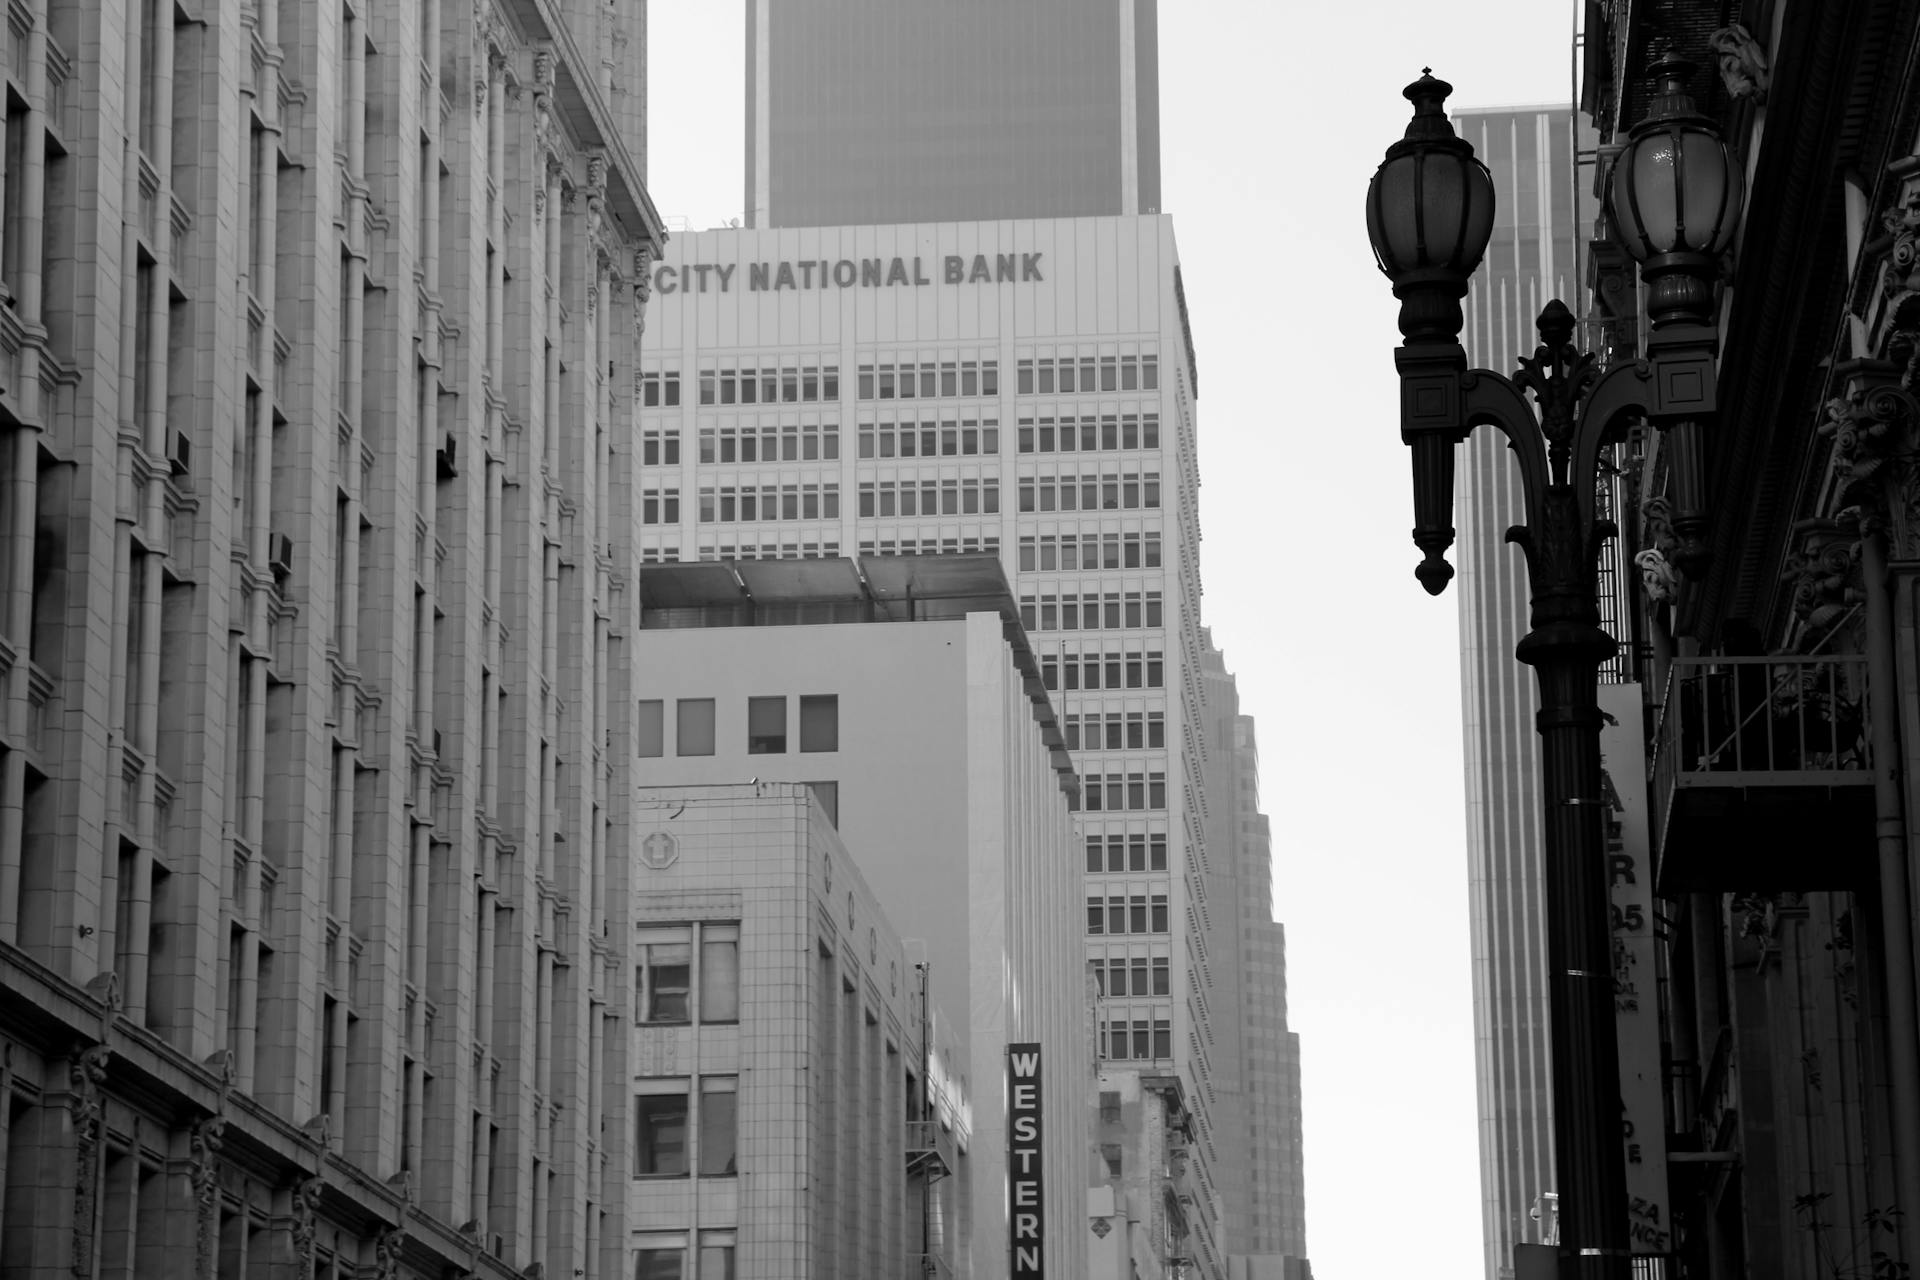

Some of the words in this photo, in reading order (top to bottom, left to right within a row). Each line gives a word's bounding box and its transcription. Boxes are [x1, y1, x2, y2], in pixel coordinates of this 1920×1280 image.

[654, 263, 736, 295] CITY
[749, 256, 930, 292] NATIONAL
[944, 252, 1044, 285] BANK
[1010, 1053, 1039, 1272] WESTERN
